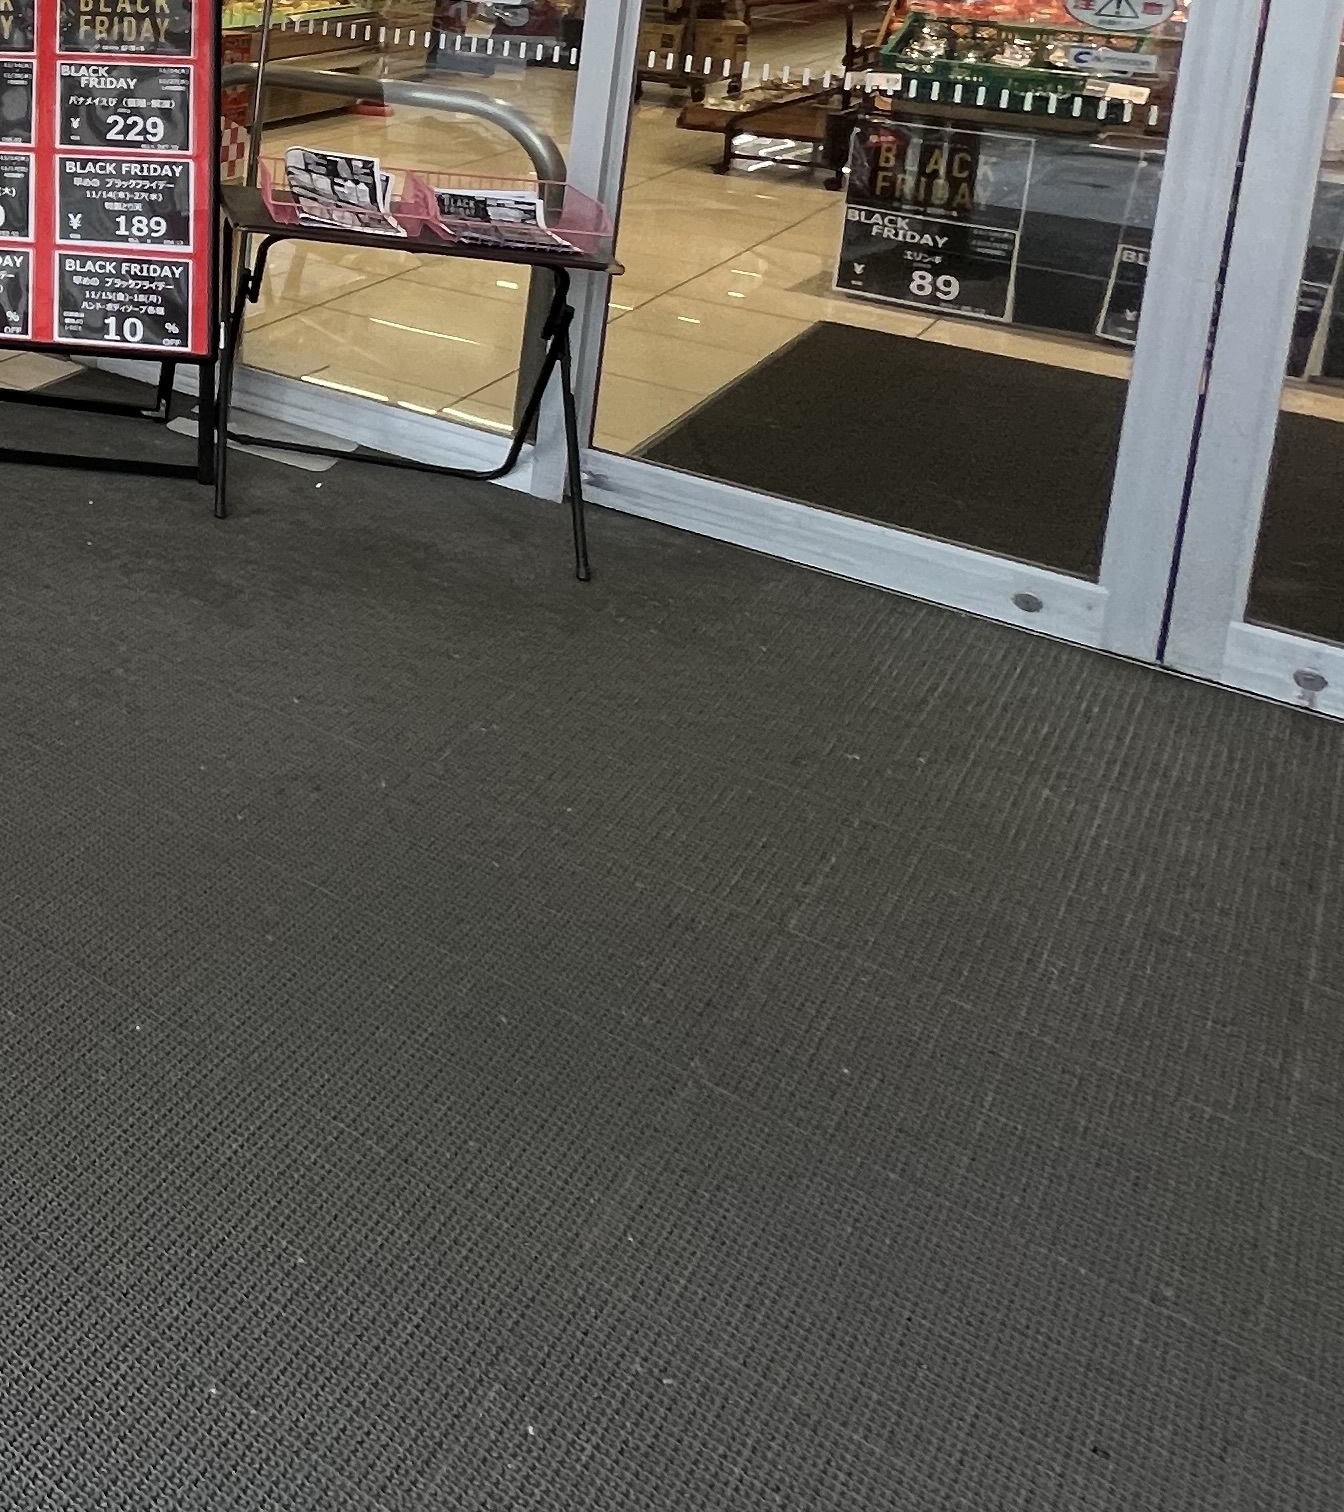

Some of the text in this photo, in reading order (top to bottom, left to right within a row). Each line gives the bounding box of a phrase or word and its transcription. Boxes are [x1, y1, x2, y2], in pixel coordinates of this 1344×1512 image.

[79, 16, 170, 43] FRIDAY
[60, 65, 109, 77] BLACK
[80, 77, 138, 89] FRIDAY
[106, 115, 165, 142] 229
[65, 161, 183, 177] BLACK FRIDAY
[879, 143, 995, 182] BACK
[67, 213, 168, 238] ¥ 189
[846, 209, 911, 231] BLACK
[871, 225, 949, 249] FRIDAY
[65, 258, 183, 278] BLACK FRIDAY
[909, 270, 960, 301] 89
[6, 310, 20, 322] %
[103, 316, 144, 342] 10
[164, 322, 180, 334] %
